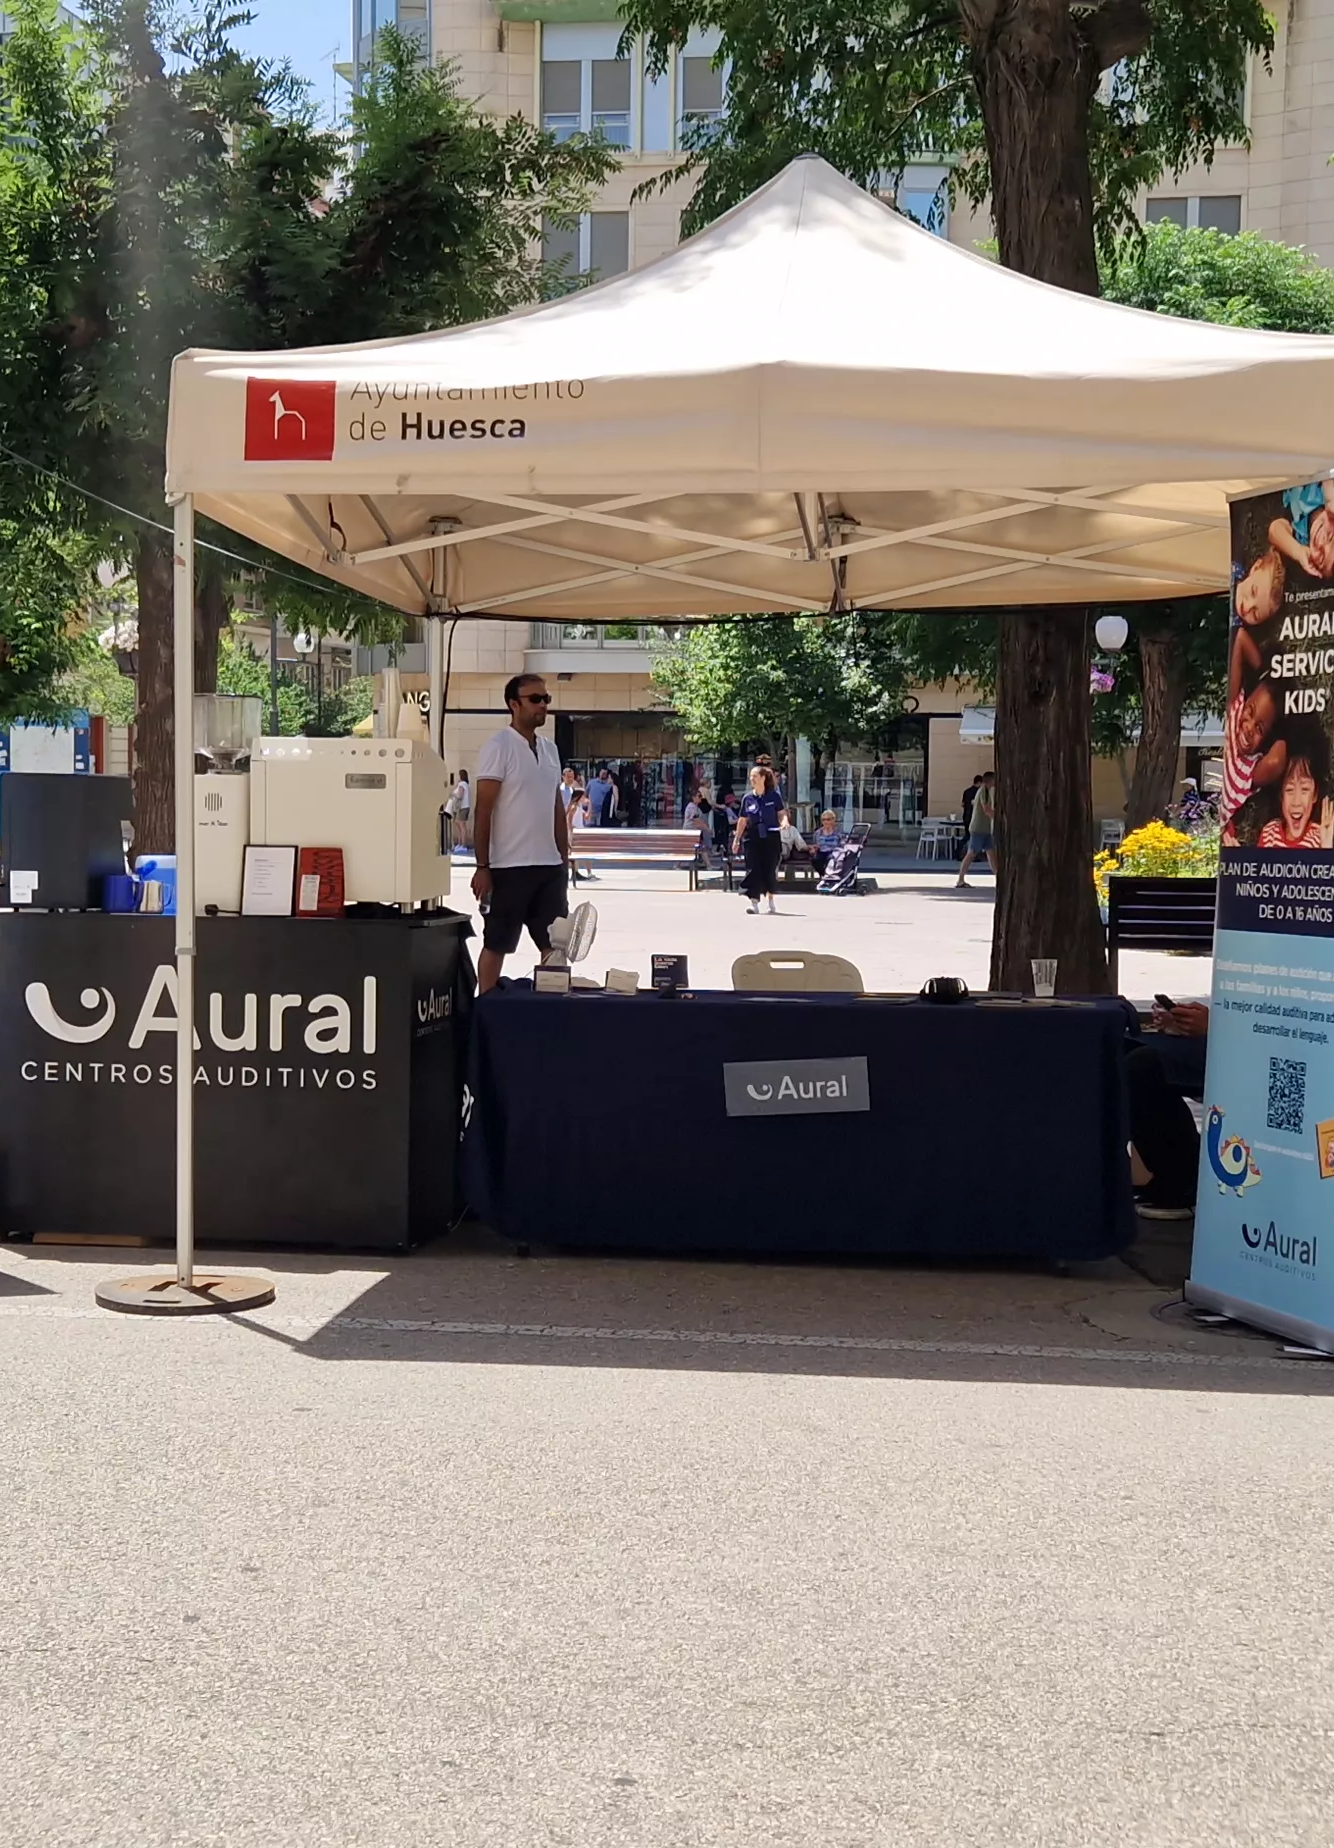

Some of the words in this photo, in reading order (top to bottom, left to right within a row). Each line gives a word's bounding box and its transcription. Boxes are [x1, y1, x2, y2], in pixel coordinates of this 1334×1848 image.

[349, 412, 387, 442] de
[400, 412, 527, 441] Huesca
[1284, 592, 1294, 602] Te
[1219, 862, 1240, 876] PLAN
[1243, 863, 1258, 876] DE
[1260, 861, 1309, 879] AUDICIÓN
[1236, 881, 1269, 898] NIÑOS
[1272, 884, 1280, 898] Y
[1259, 904, 1274, 919] DE
[1286, 906, 1294, 920] A
[1295, 906, 1304, 921] 16
[1306, 905, 1333, 922] AÑOS
[128, 965, 377, 1054] Aural
[428, 986, 453, 1021] Aural
[1231, 1000, 1253, 1014] mejor
[1254, 1002, 1281, 1016] calidad
[1309, 1011, 1325, 1023] para
[21, 1060, 174, 1085] CENTROS
[193, 1065, 377, 1090] AUDITIVOS
[777, 1075, 847, 1100] Aural
[1264, 1221, 1317, 1267] Aural
